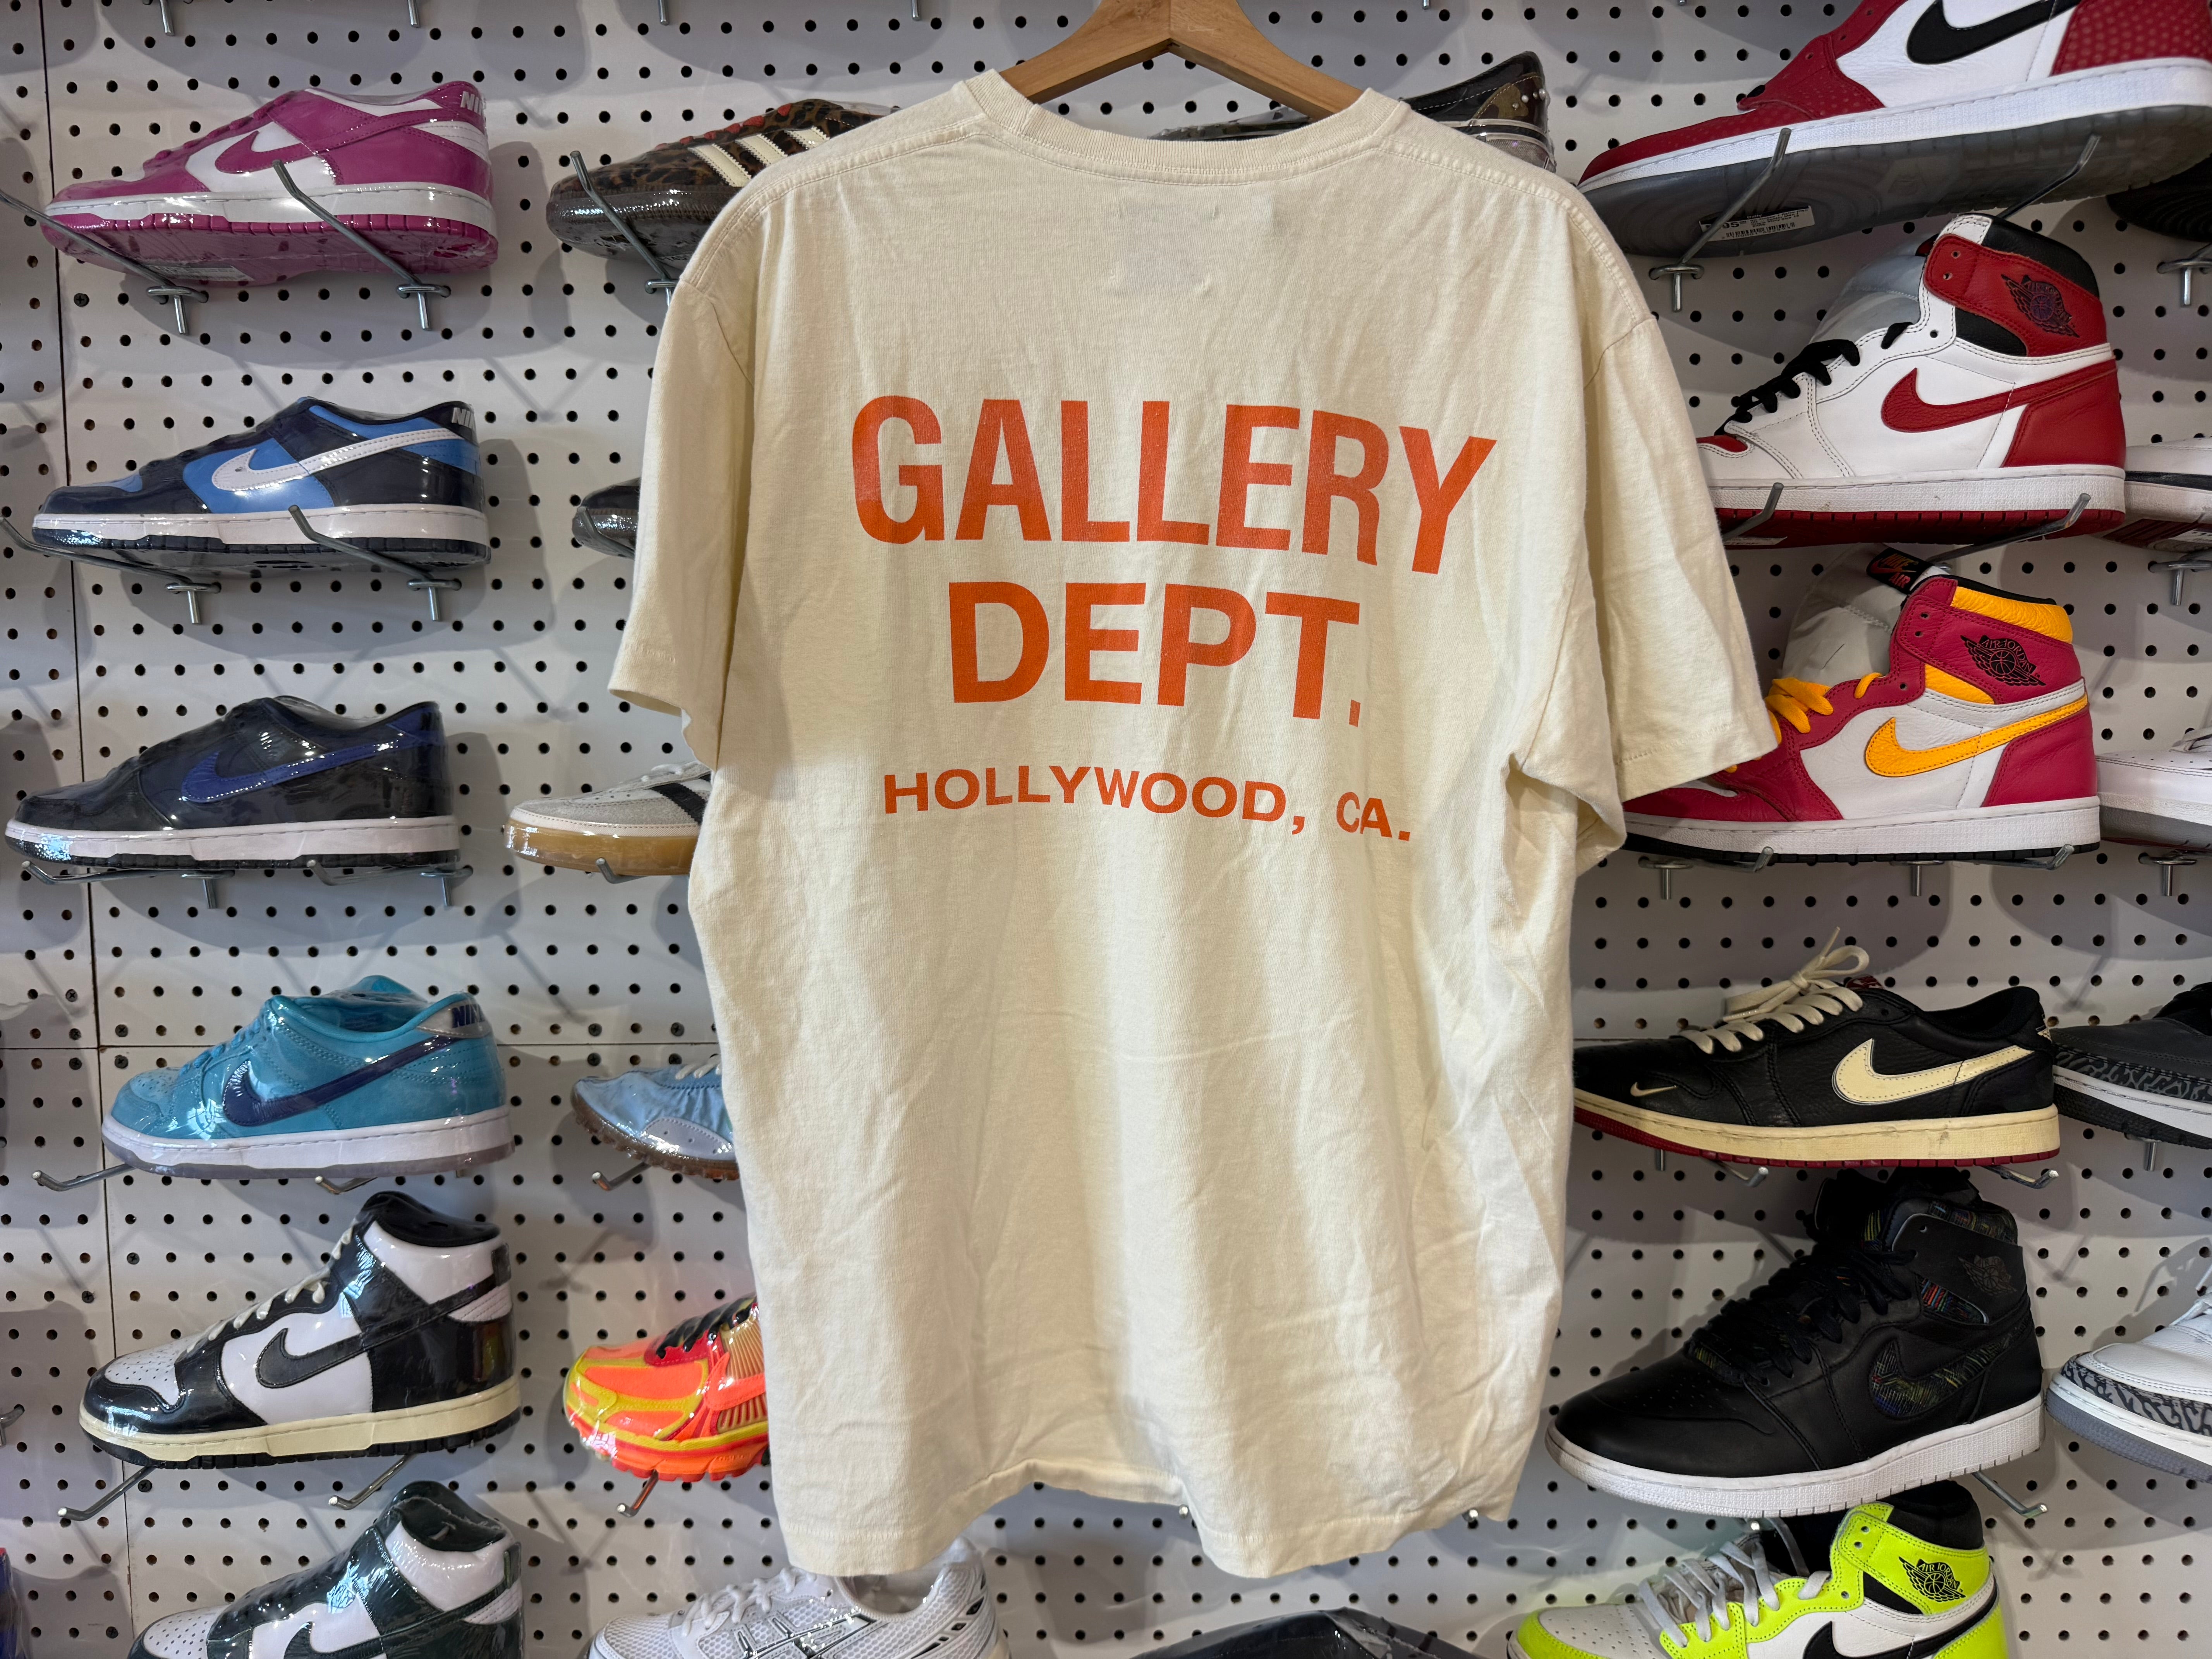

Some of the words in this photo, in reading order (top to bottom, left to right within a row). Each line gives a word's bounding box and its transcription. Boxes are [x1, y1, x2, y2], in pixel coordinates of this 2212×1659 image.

[852, 395, 1496, 574] GALLERY
[949, 581, 1360, 727] DEPT.
[1982, 639, 2001, 648] AIR
[884, 765, 1306, 835] HOLLYWOOD,
[1336, 792, 1410, 841] CA.
[1918, 1563, 1934, 1572] AIR
